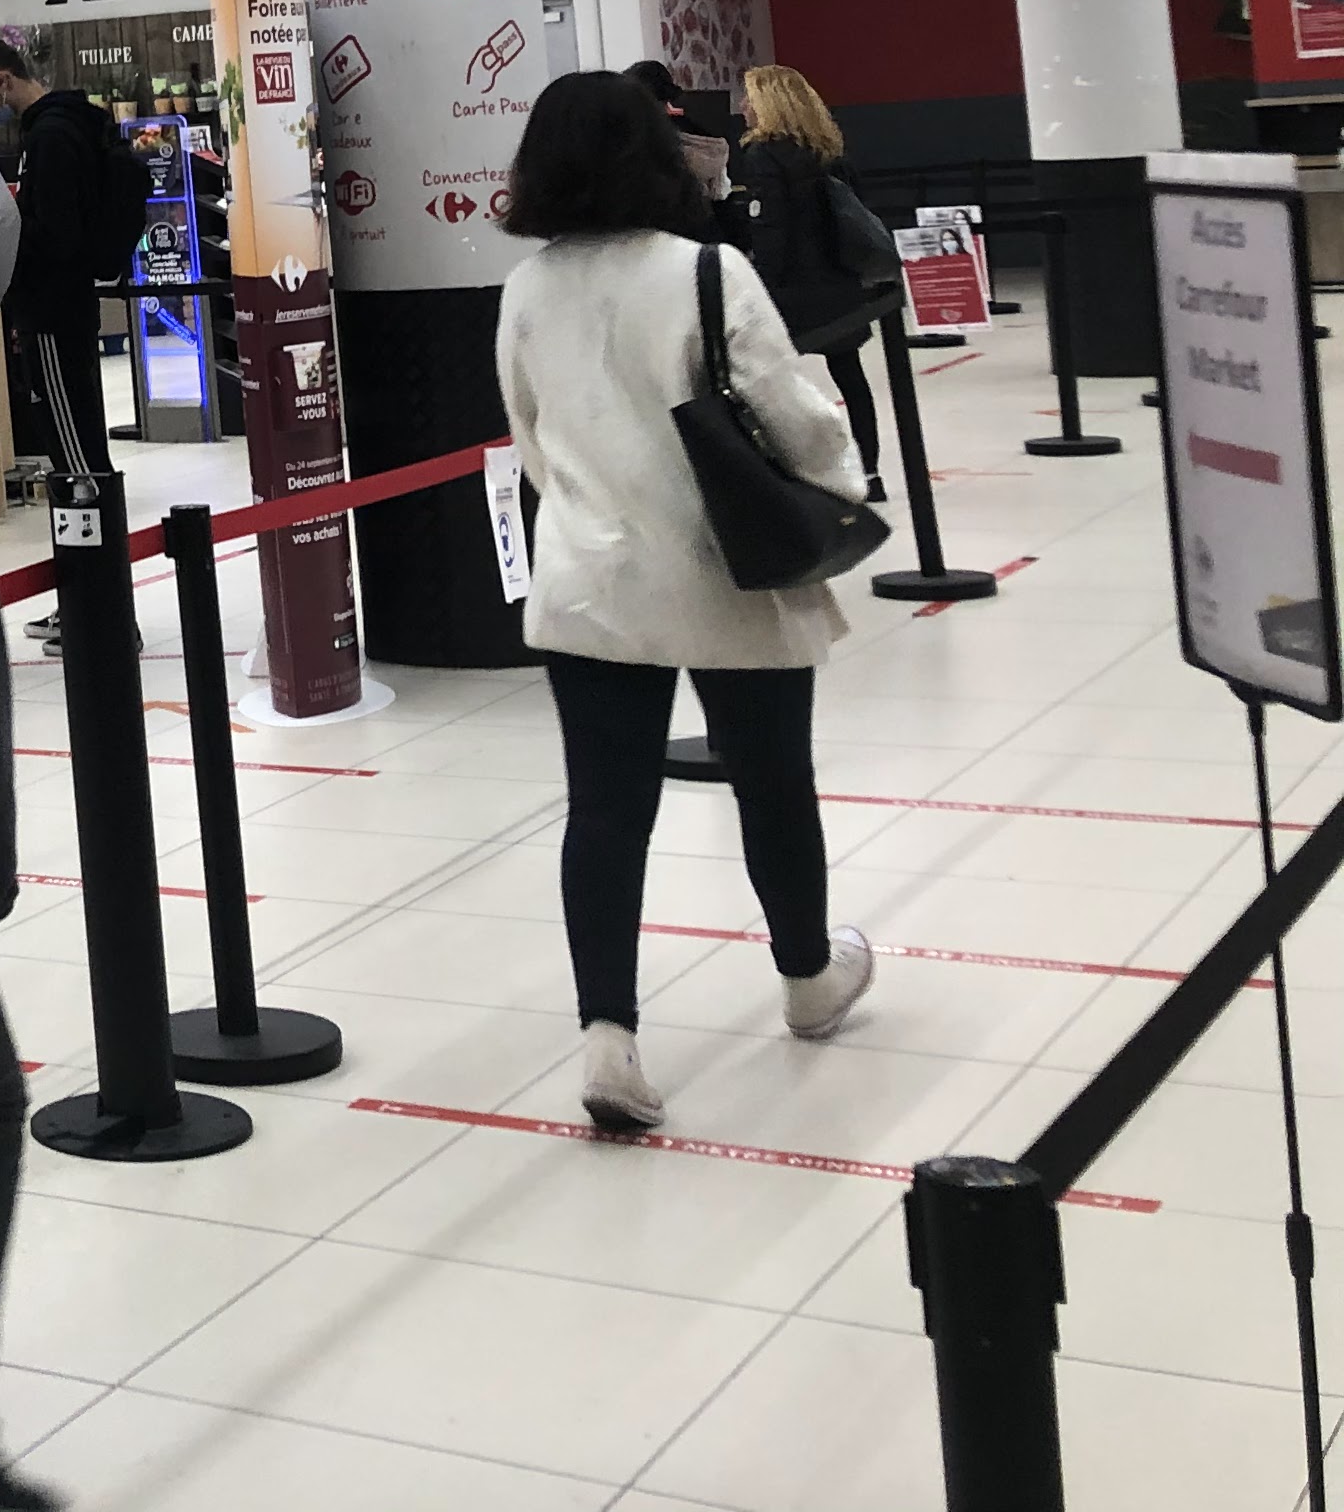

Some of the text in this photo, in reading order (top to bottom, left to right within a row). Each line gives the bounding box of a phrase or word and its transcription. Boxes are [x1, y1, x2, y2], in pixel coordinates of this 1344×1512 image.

[248, 0, 287, 18] Foire
[250, 23, 293, 45] notée
[79, 46, 133, 66] TULIPE
[452, 98, 529, 118] Carte Pass
[295, 392, 327, 407] SERVEZ
[298, 407, 327, 421] -VOUS
[293, 532, 312, 544] vos
